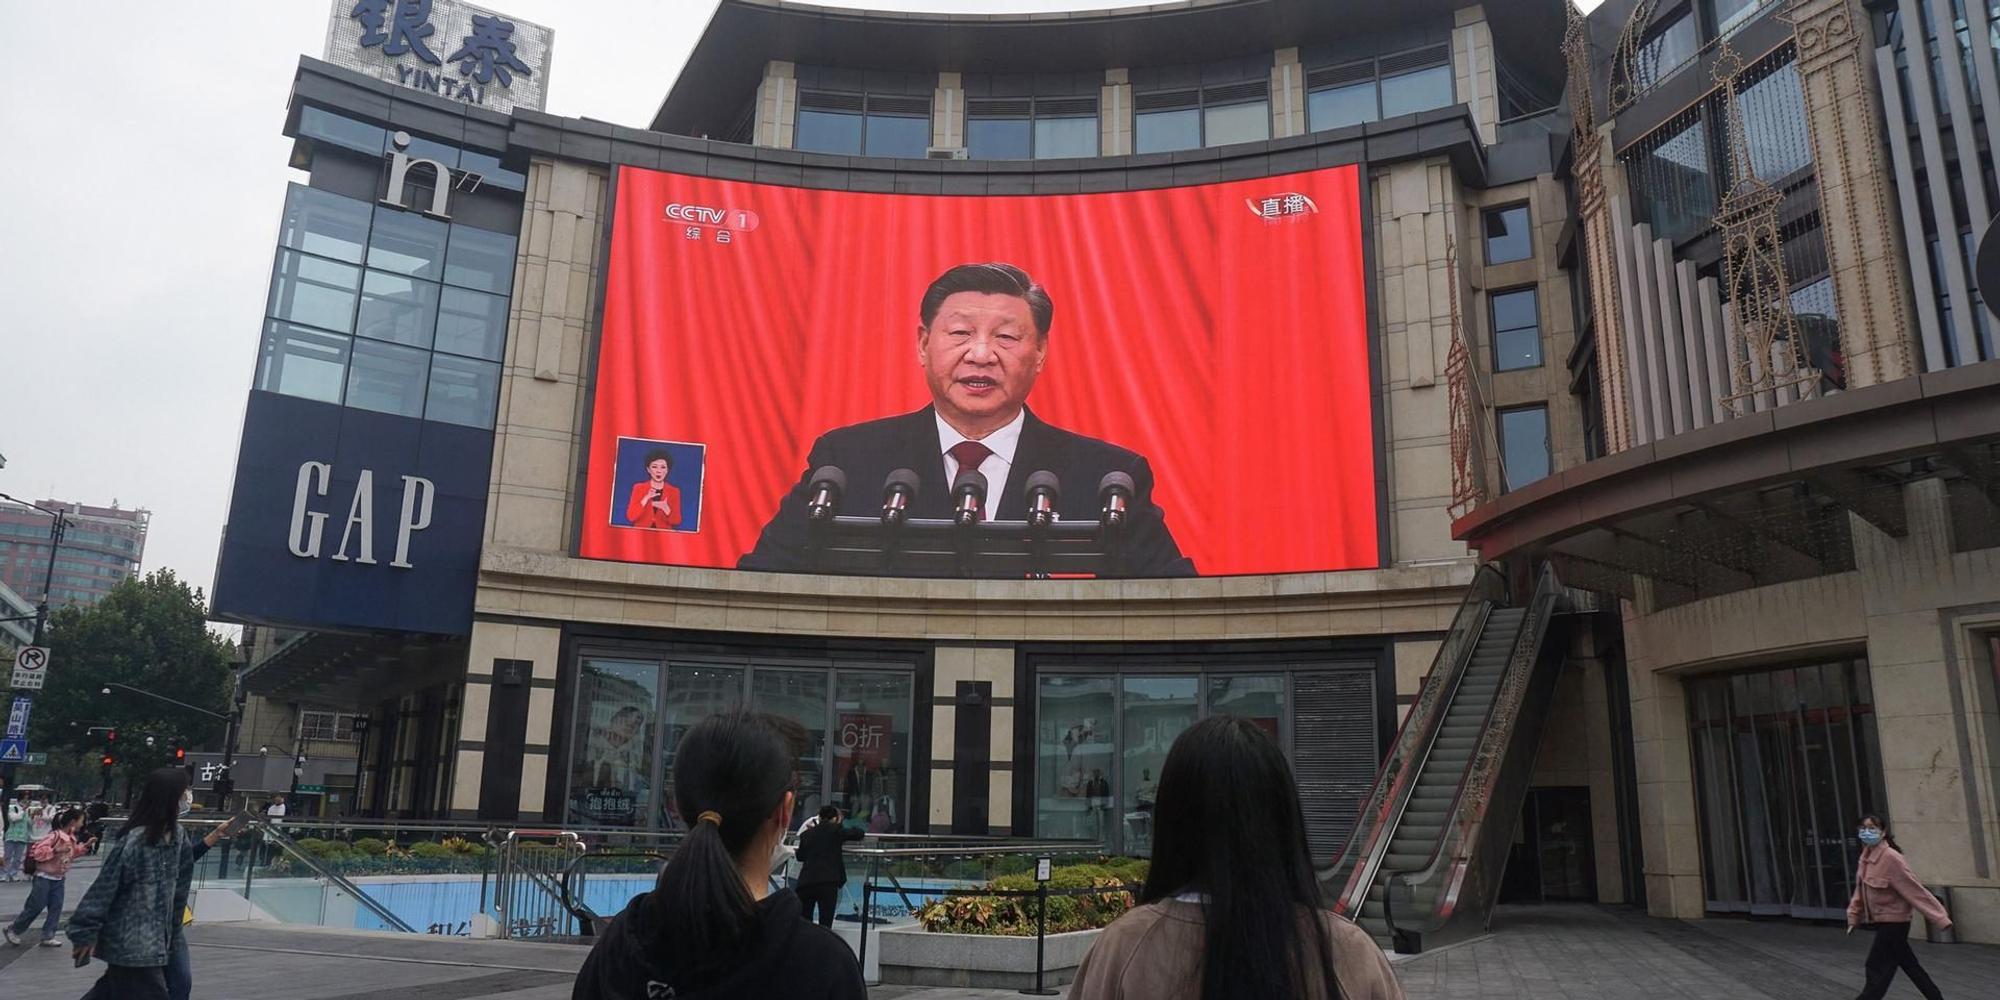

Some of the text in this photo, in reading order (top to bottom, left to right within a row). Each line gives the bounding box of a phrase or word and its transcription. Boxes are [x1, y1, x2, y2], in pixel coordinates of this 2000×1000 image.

[351, 0, 532, 88] 银泰
[398, 64, 485, 104] YINTAI
[666, 203, 726, 224] CCTV
[1261, 195, 1305, 217] 直播
[685, 226, 731, 243] 综合
[288, 460, 435, 568] GAP
[842, 723, 884, 748] 6折
